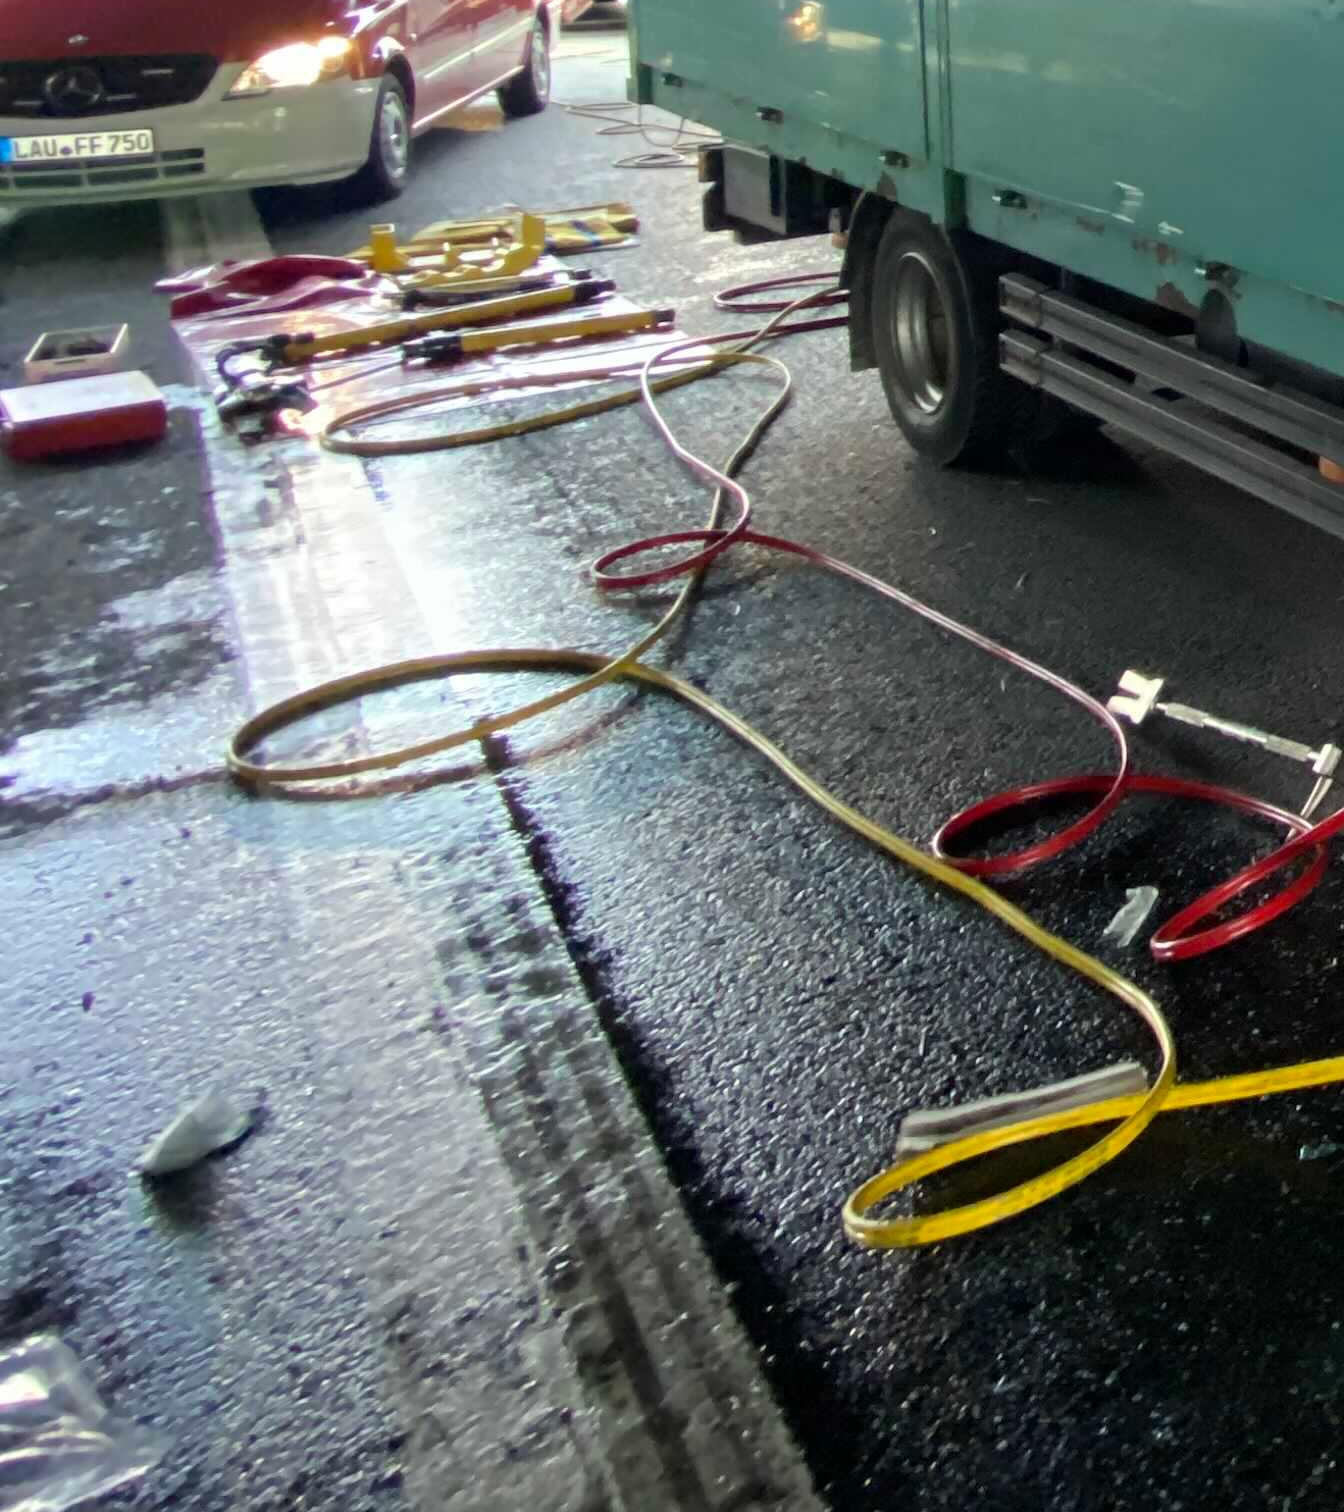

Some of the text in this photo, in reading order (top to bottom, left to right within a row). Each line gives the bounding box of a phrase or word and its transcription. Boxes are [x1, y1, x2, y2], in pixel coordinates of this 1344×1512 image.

[14, 133, 149, 159] LAU FF 750
